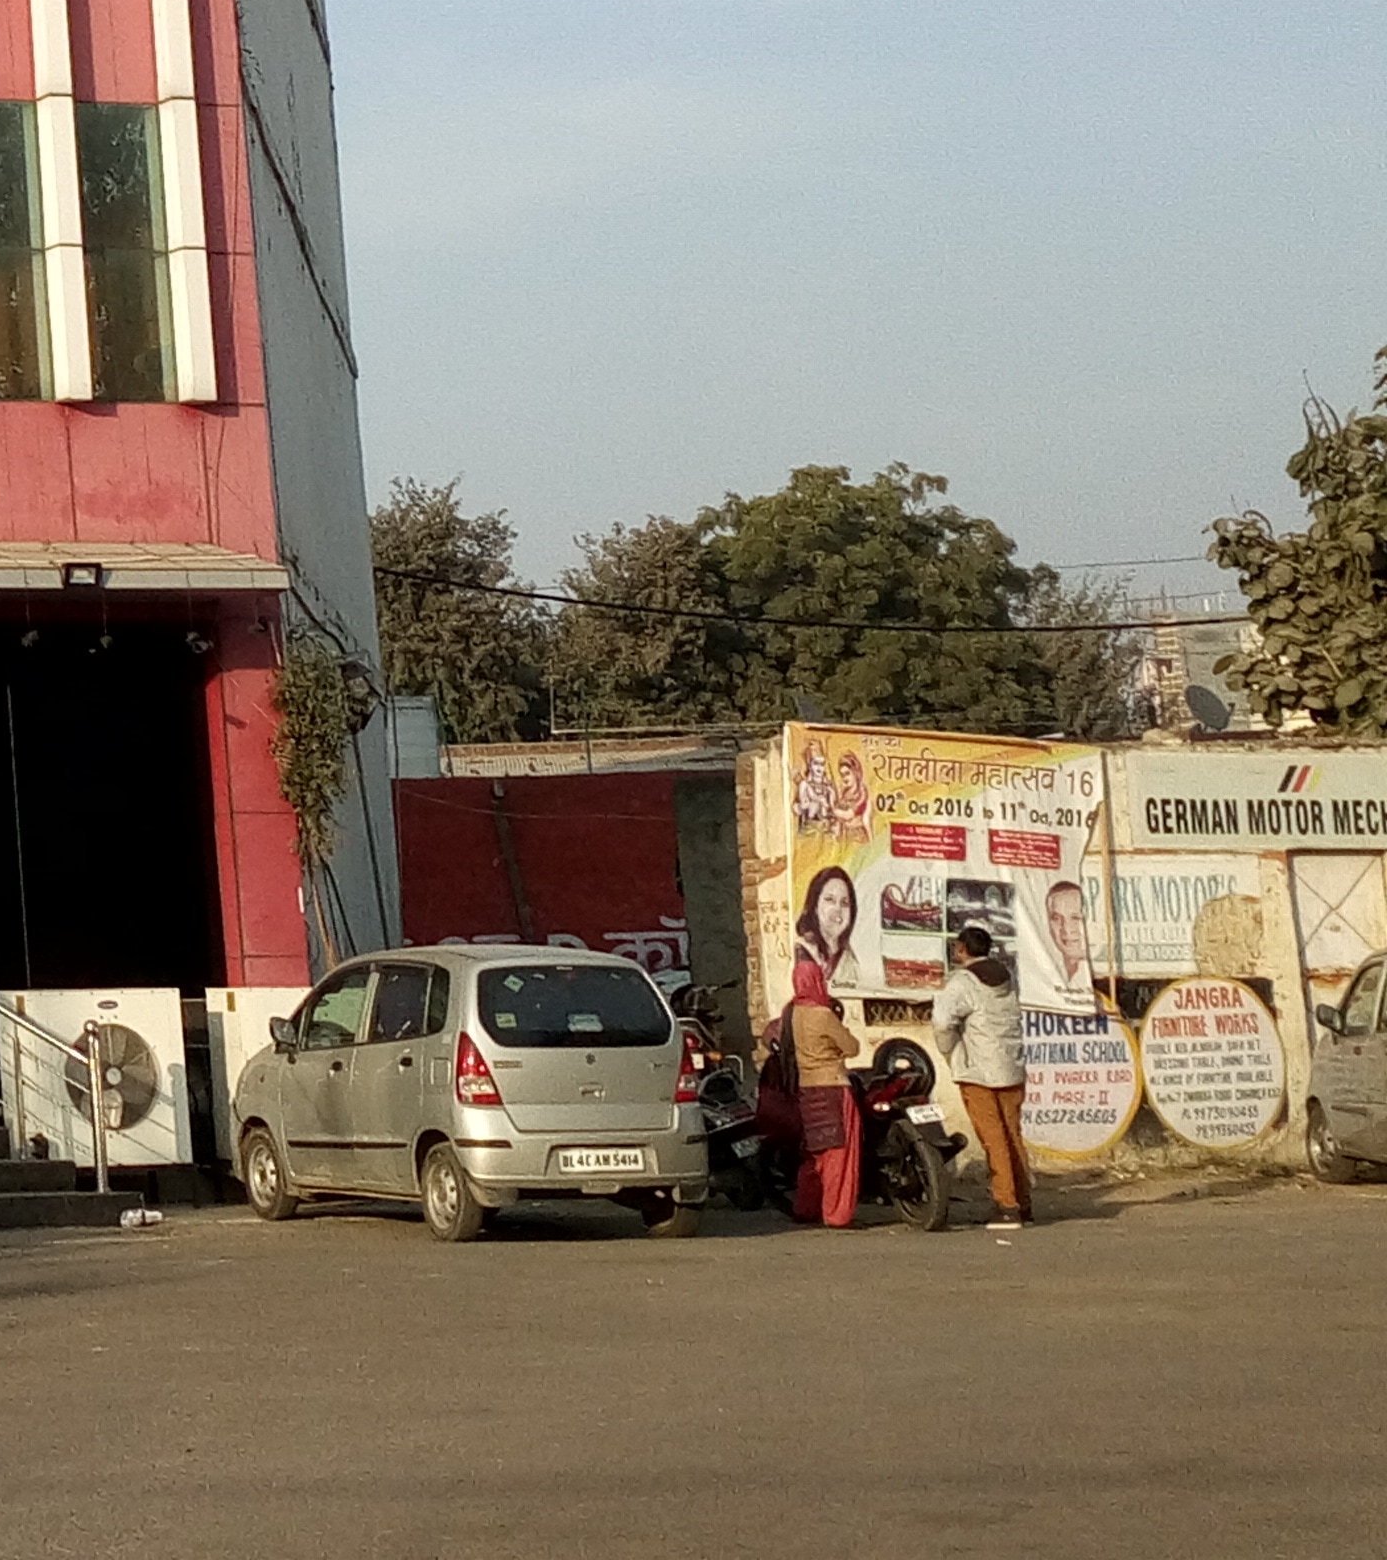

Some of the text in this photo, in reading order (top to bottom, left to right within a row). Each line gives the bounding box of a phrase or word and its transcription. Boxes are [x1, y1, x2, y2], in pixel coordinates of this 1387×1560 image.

[934, 798, 974, 818] 2016
[1146, 797, 1239, 834] GERMAN
[1247, 798, 1326, 836] MOTOR
[1174, 986, 1244, 1010] JANGRA
[1026, 1011, 1109, 1037] HOKEEN
[1215, 1013, 1259, 1035] WORKS
[1025, 1040, 1129, 1064] NATIONAL SCHOOL
